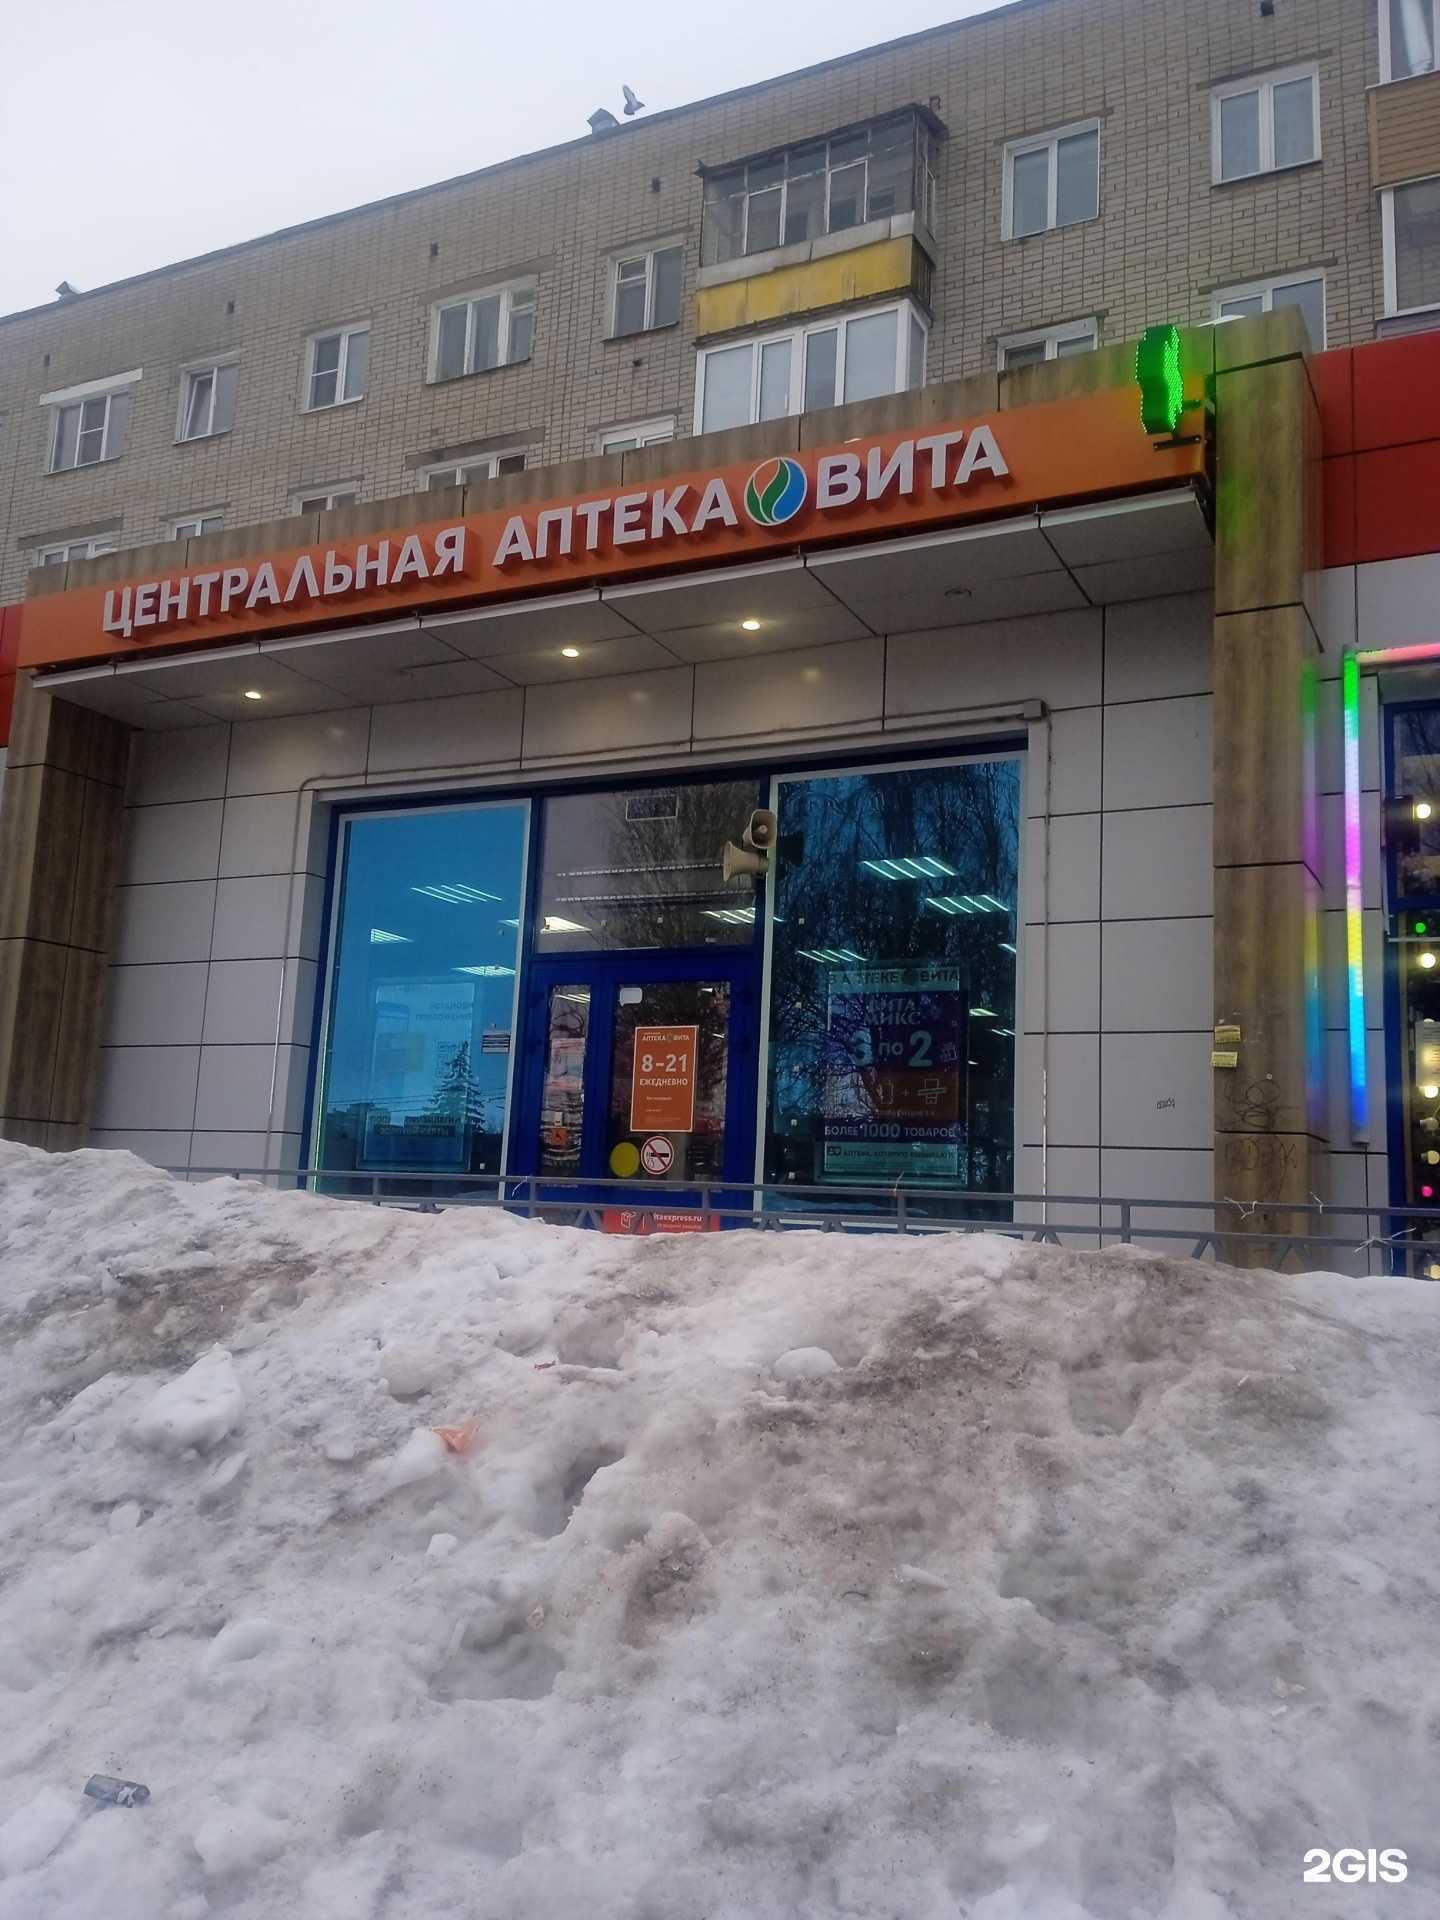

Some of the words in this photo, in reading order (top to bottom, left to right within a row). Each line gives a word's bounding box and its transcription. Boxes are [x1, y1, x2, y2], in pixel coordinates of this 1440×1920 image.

[102, 526, 467, 638] ЦЕНТРАЛЬНАЯ
[491, 478, 739, 566] АПТЕКА
[815, 425, 1009, 510] ВИТА
[919, 968, 959, 983] ВИТА
[909, 1031, 933, 1067] 2
[641, 1054, 688, 1073] 8-21
[639, 1078, 689, 1087] ЕЖЕДНЕВНО
[824, 1125, 860, 1136] БОЛЕЕ
[863, 1123, 901, 1138] 1000
[904, 1127, 956, 1138] ТОВАРОВ
